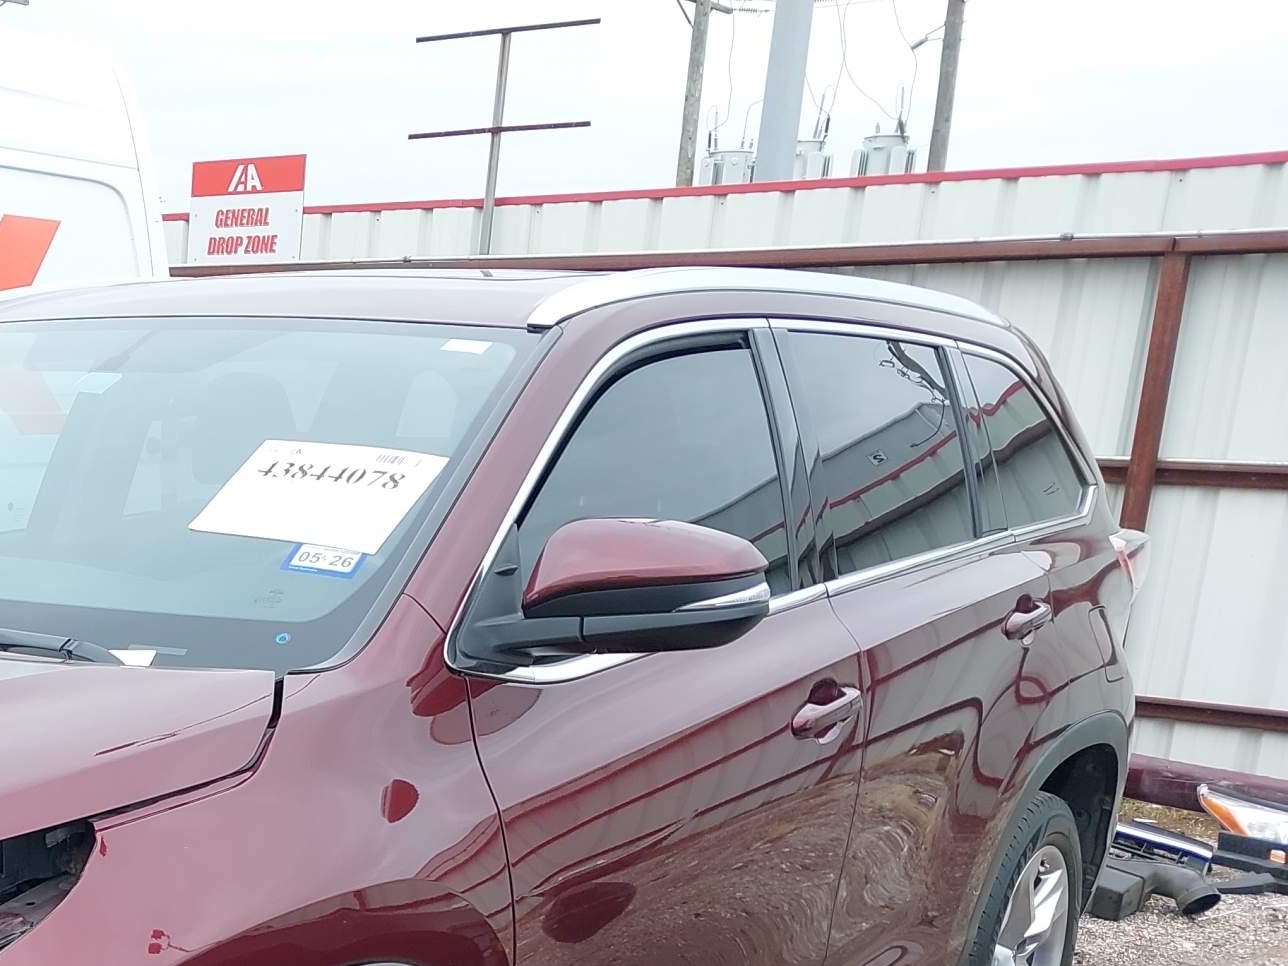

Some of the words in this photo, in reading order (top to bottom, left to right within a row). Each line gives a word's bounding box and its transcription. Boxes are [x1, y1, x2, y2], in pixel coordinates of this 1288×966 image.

[215, 207, 270, 229] GENERAL
[207, 235, 244, 256] DROP
[244, 234, 278, 254] ZONE
[258, 461, 406, 490] 43844078
[298, 551, 322, 564] 05
[328, 555, 355, 568] 26
